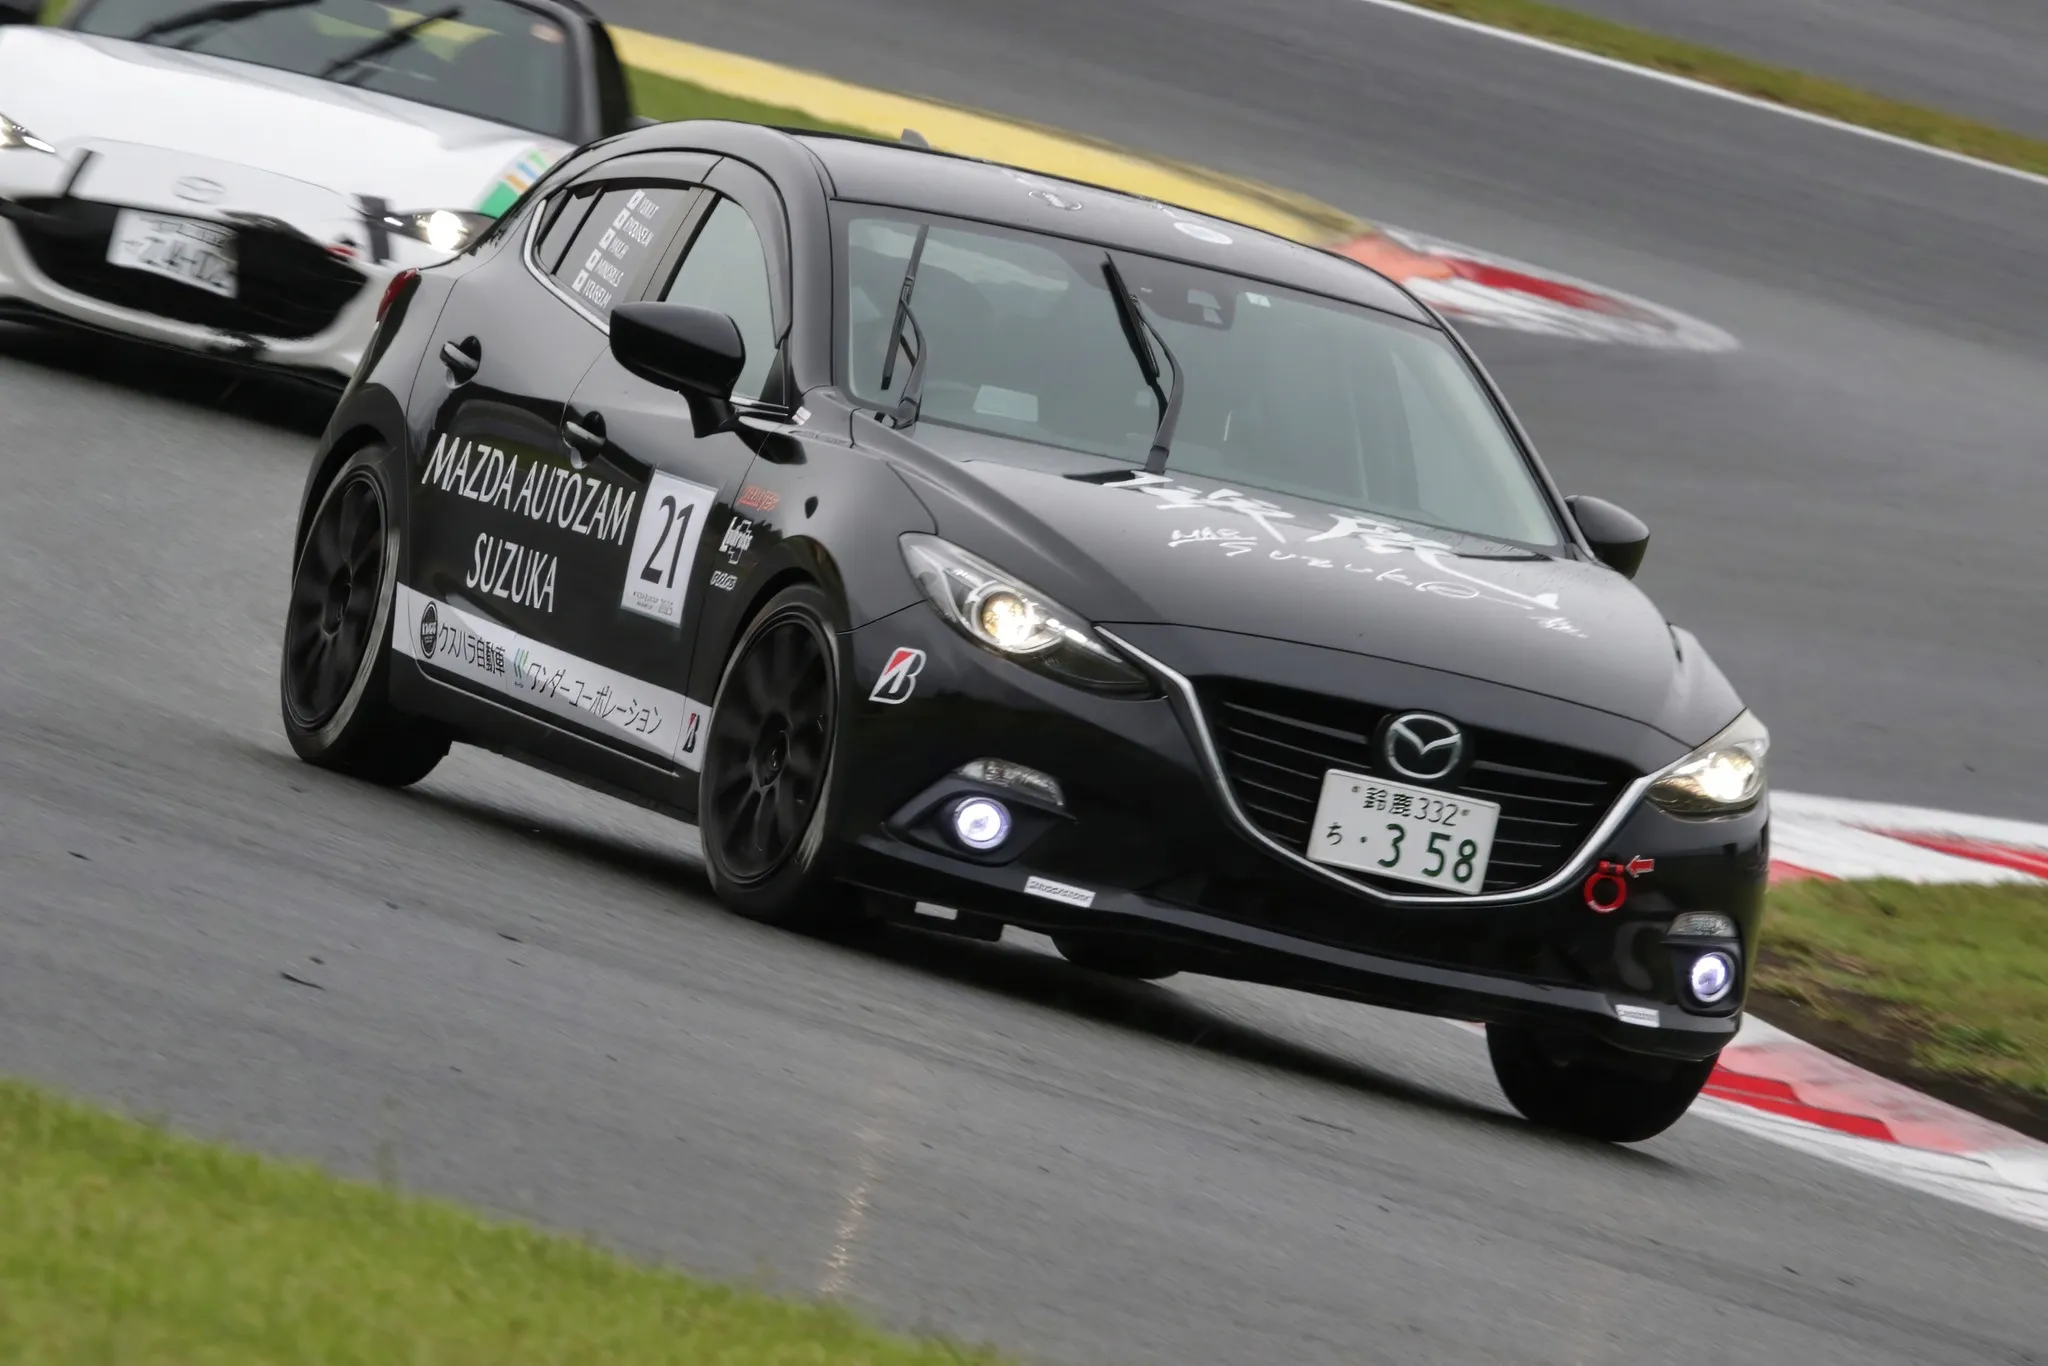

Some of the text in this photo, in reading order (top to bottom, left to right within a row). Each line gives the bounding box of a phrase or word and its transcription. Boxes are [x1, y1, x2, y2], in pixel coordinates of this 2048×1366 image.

[421, 433, 637, 546] MAZDA AUTOZAM
[466, 532, 558, 613] SUZUKA
[640, 495, 695, 589] 21
[527, 662, 662, 735] ワンダーコーポレーション
